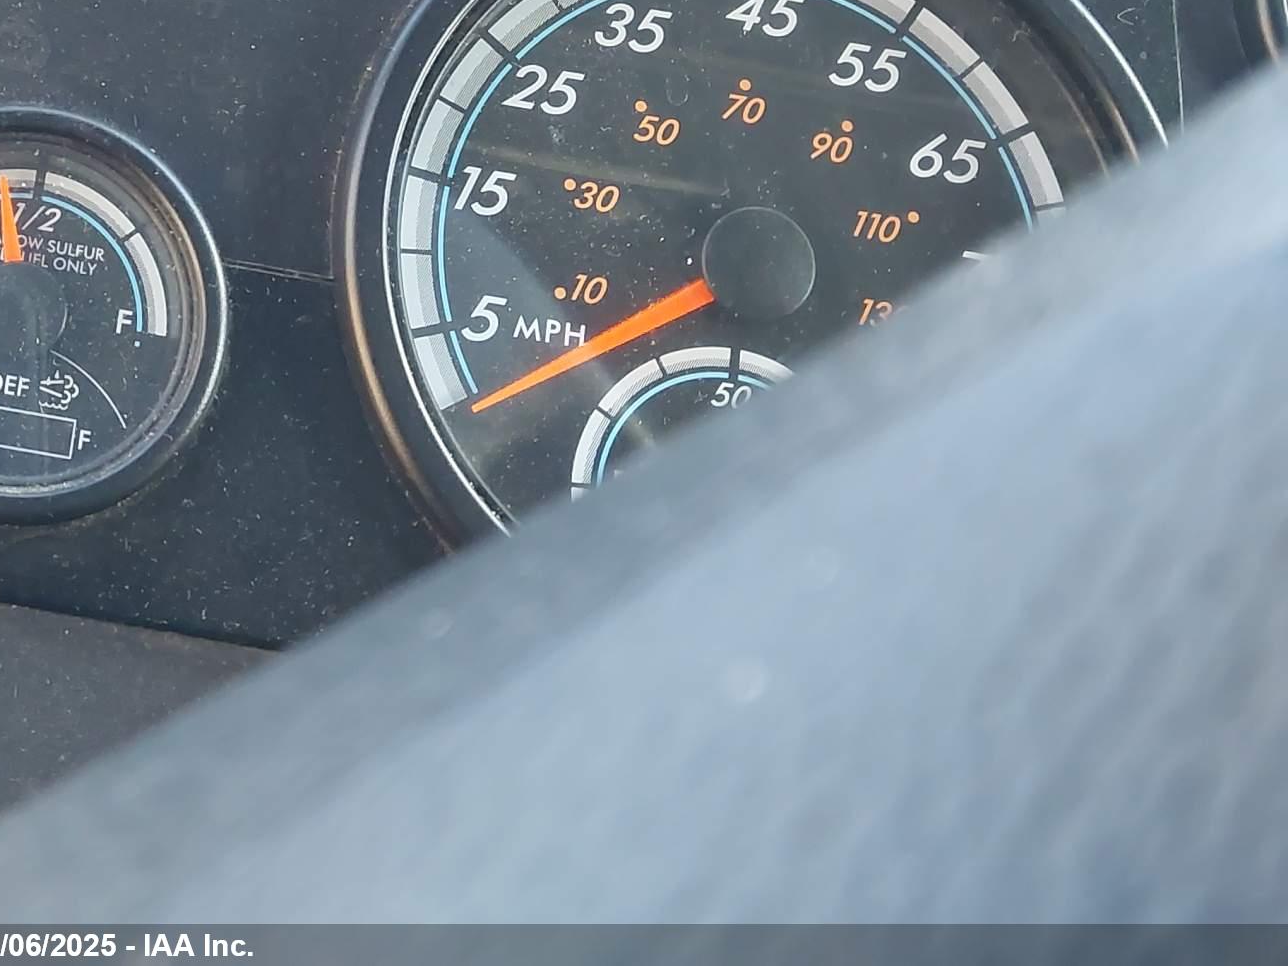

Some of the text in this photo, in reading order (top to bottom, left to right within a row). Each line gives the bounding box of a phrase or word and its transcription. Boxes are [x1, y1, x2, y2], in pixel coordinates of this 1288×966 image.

[595, 3, 673, 53] 35
[828, 42, 907, 92] 55
[501, 64, 585, 115] 25
[721, 93, 766, 124] 70
[633, 114, 680, 145] 50
[810, 132, 853, 163] 90
[909, 133, 987, 184] 65
[454, 165, 517, 216] 15
[573, 181, 620, 213] 30
[13, 202, 62, 233] 1/2
[852, 210, 901, 243] 110
[16, 234, 44, 251] OW
[46, 239, 105, 262] SULFUR
[22, 251, 48, 268] UEL
[53, 257, 98, 277] ONLY
[571, 273, 608, 305] 10
[115, 310, 133, 335] F
[461, 294, 508, 343] 5
[512, 315, 587, 347] MPH
[77, 429, 92, 451] F
